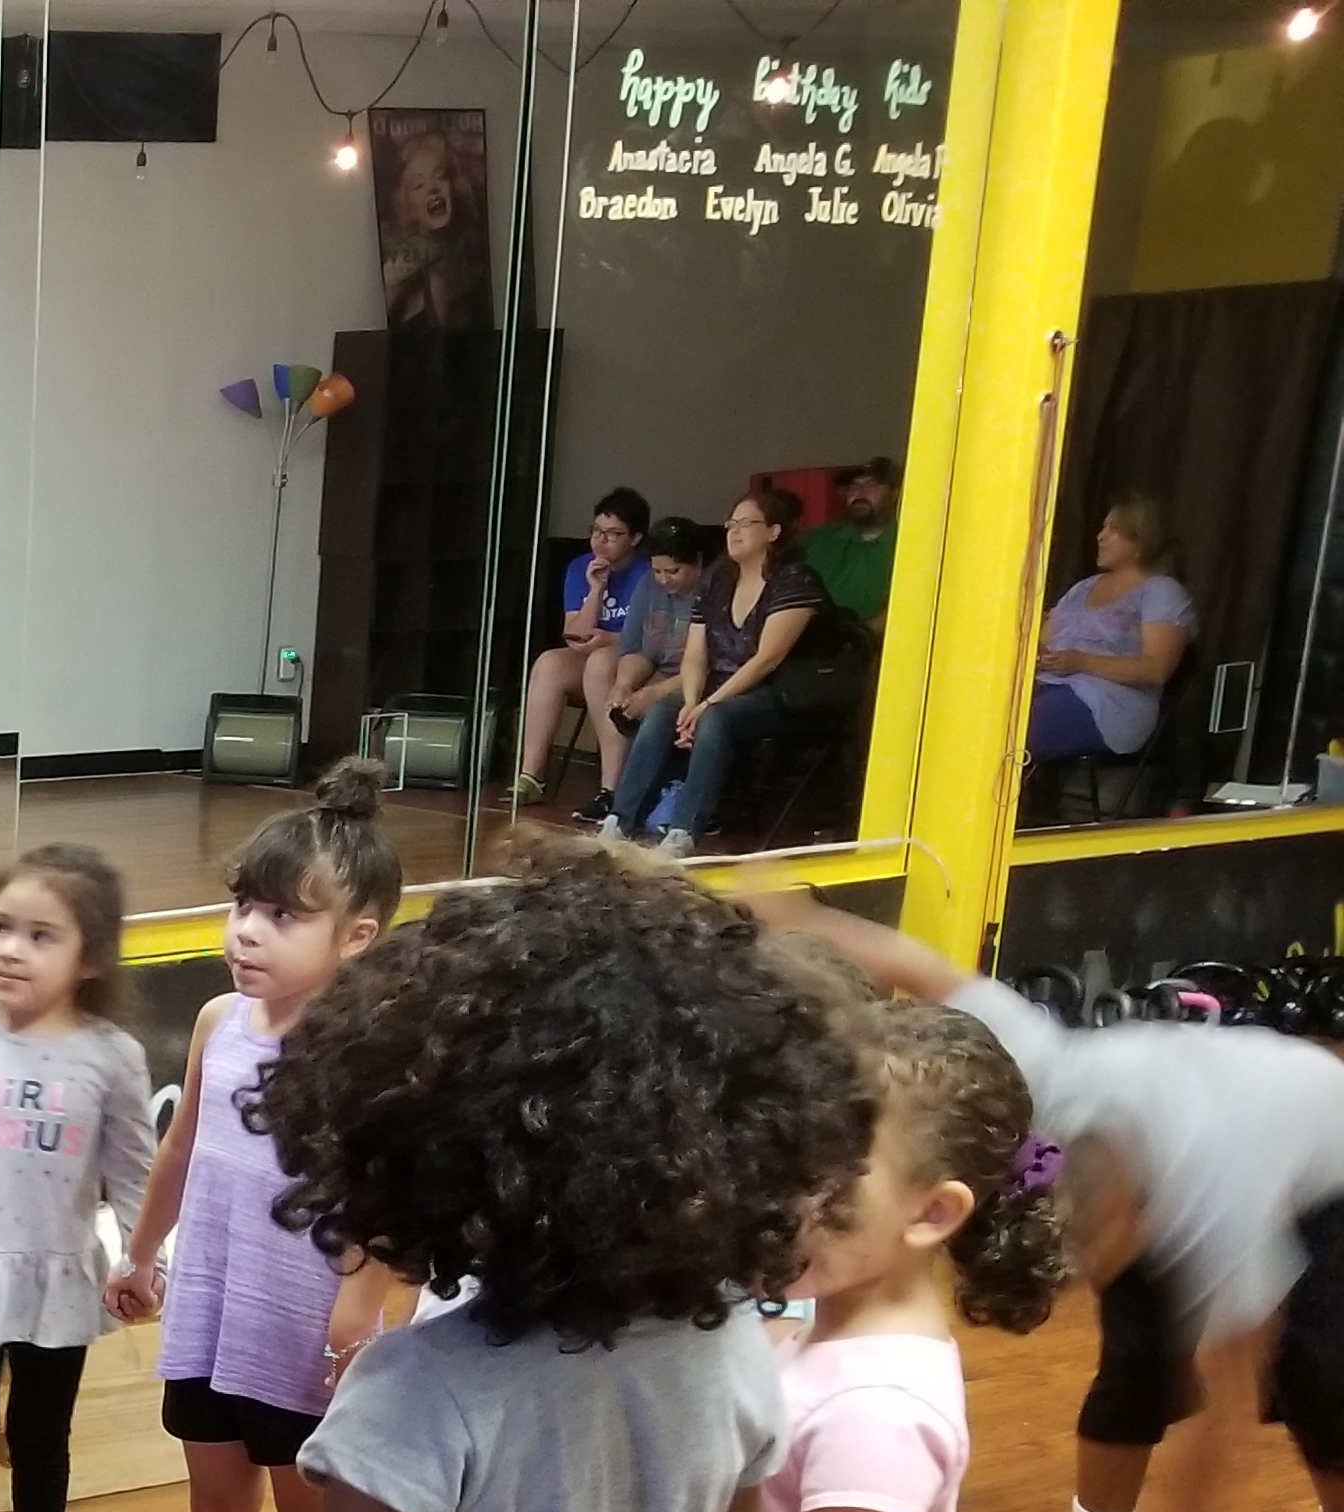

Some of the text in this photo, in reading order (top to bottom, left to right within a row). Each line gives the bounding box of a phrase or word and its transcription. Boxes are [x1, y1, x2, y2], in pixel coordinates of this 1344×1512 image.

[619, 48, 720, 132] happy
[884, 58, 932, 119] kids
[754, 142, 827, 186] Angela
[872, 141, 931, 187] Angela
[705, 186, 779, 236] Evelyn
[804, 187, 860, 224] Julie
